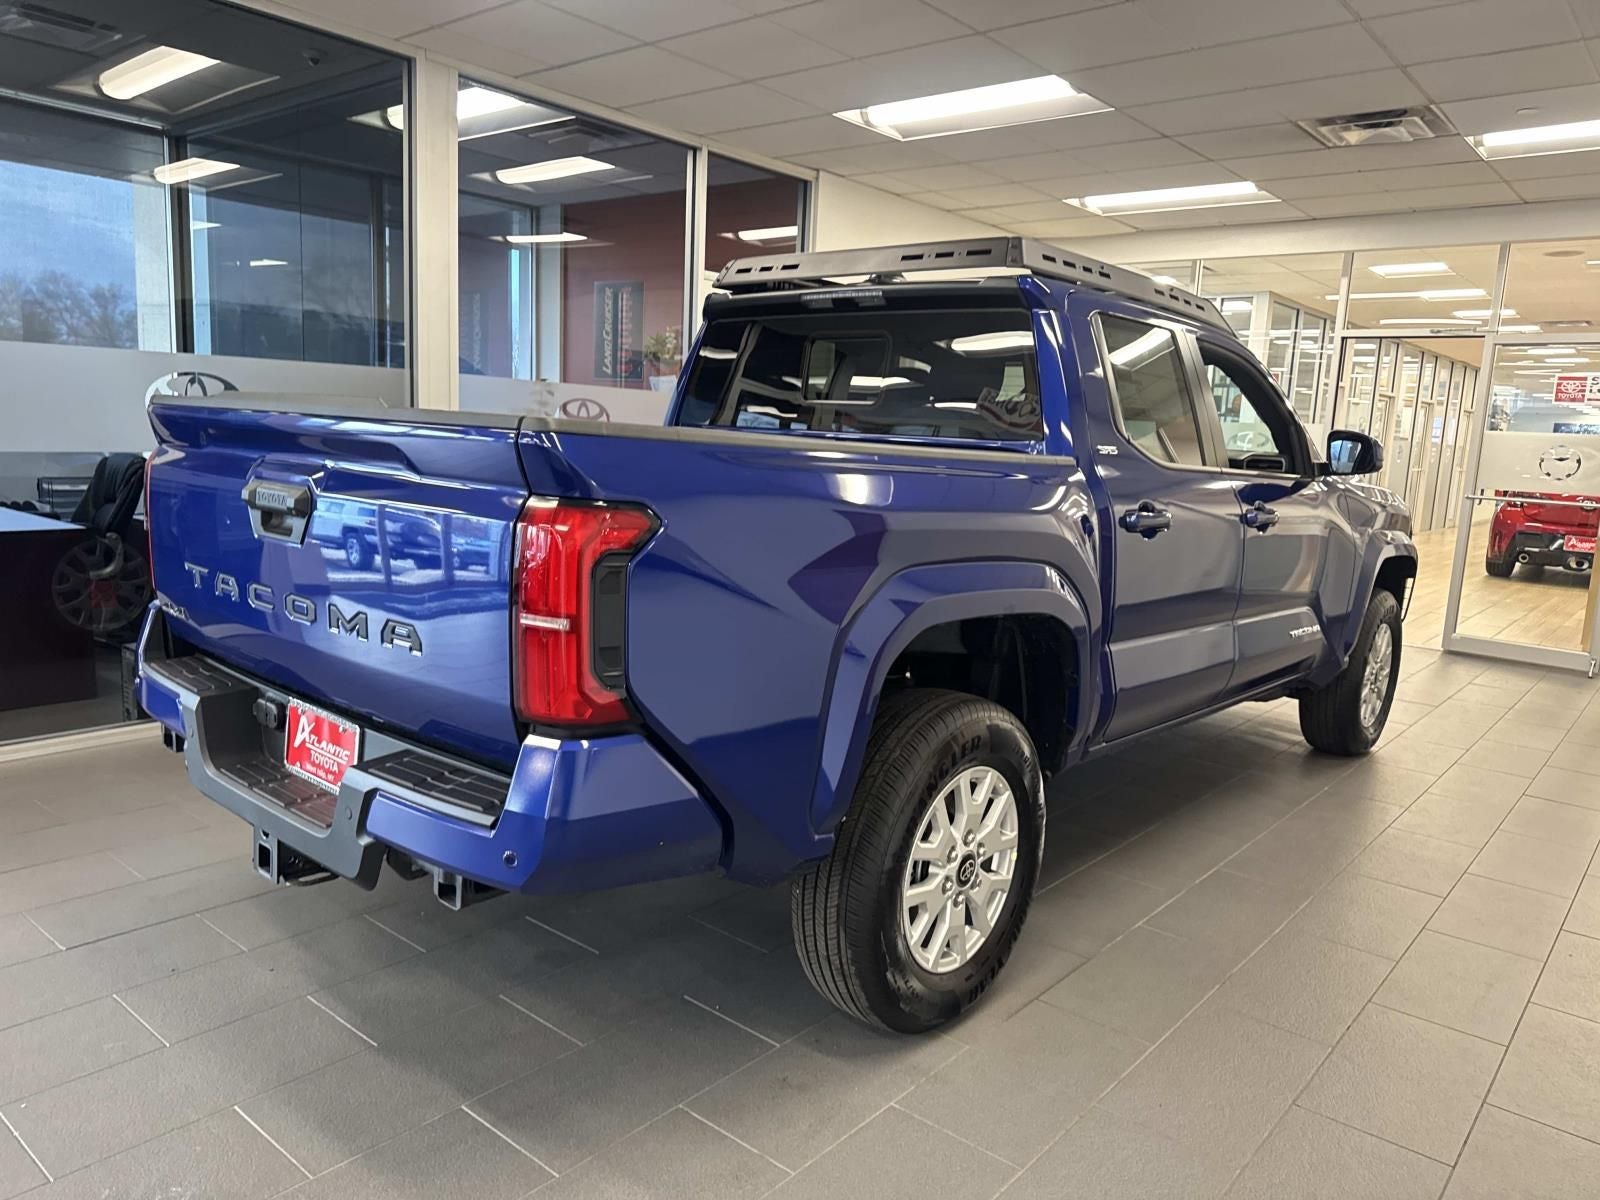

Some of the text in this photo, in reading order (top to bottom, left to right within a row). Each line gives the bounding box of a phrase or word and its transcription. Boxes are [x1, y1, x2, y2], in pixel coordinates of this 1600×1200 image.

[1557, 392, 1583, 400] TOYOTA
[257, 488, 289, 509] TOYOTA
[184, 562, 424, 657] TACOMA
[310, 750, 339, 774] TOYOTA
